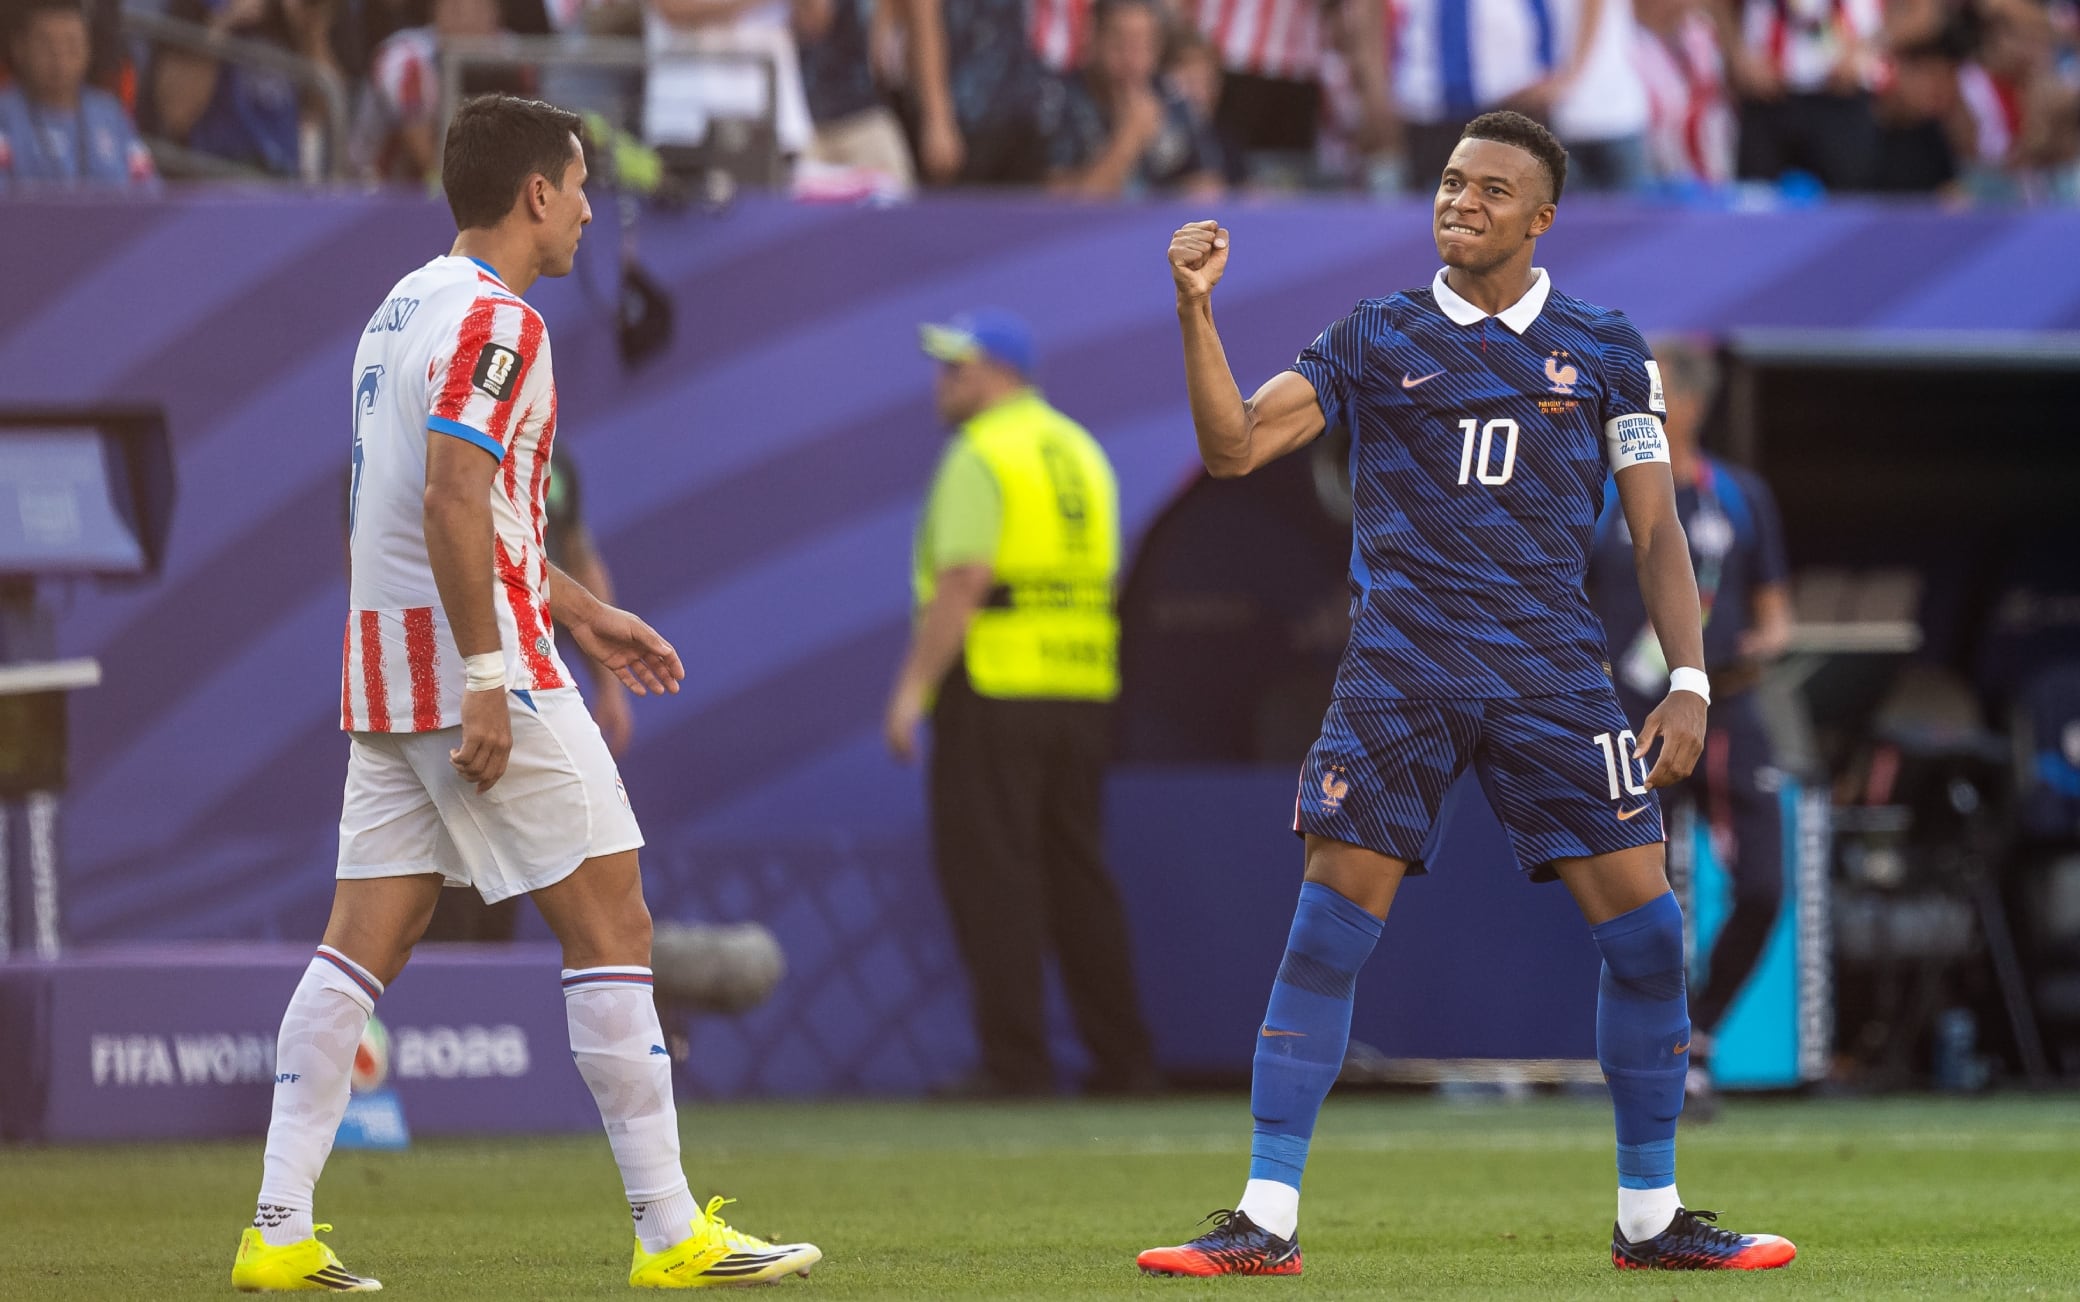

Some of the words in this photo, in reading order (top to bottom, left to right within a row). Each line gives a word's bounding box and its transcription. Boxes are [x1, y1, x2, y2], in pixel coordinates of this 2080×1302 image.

[367, 296, 420, 333] LONSO
[1617, 417, 1655, 431] FOOTBALL
[1619, 426, 1658, 443] UNITES
[1458, 418, 1519, 485] 10
[1620, 443, 1637, 455] the
[1637, 439, 1662, 453] World
[1593, 729, 1648, 800] 10
[92, 1034, 174, 1086] FIFA
[398, 1026, 528, 1077] 2026
